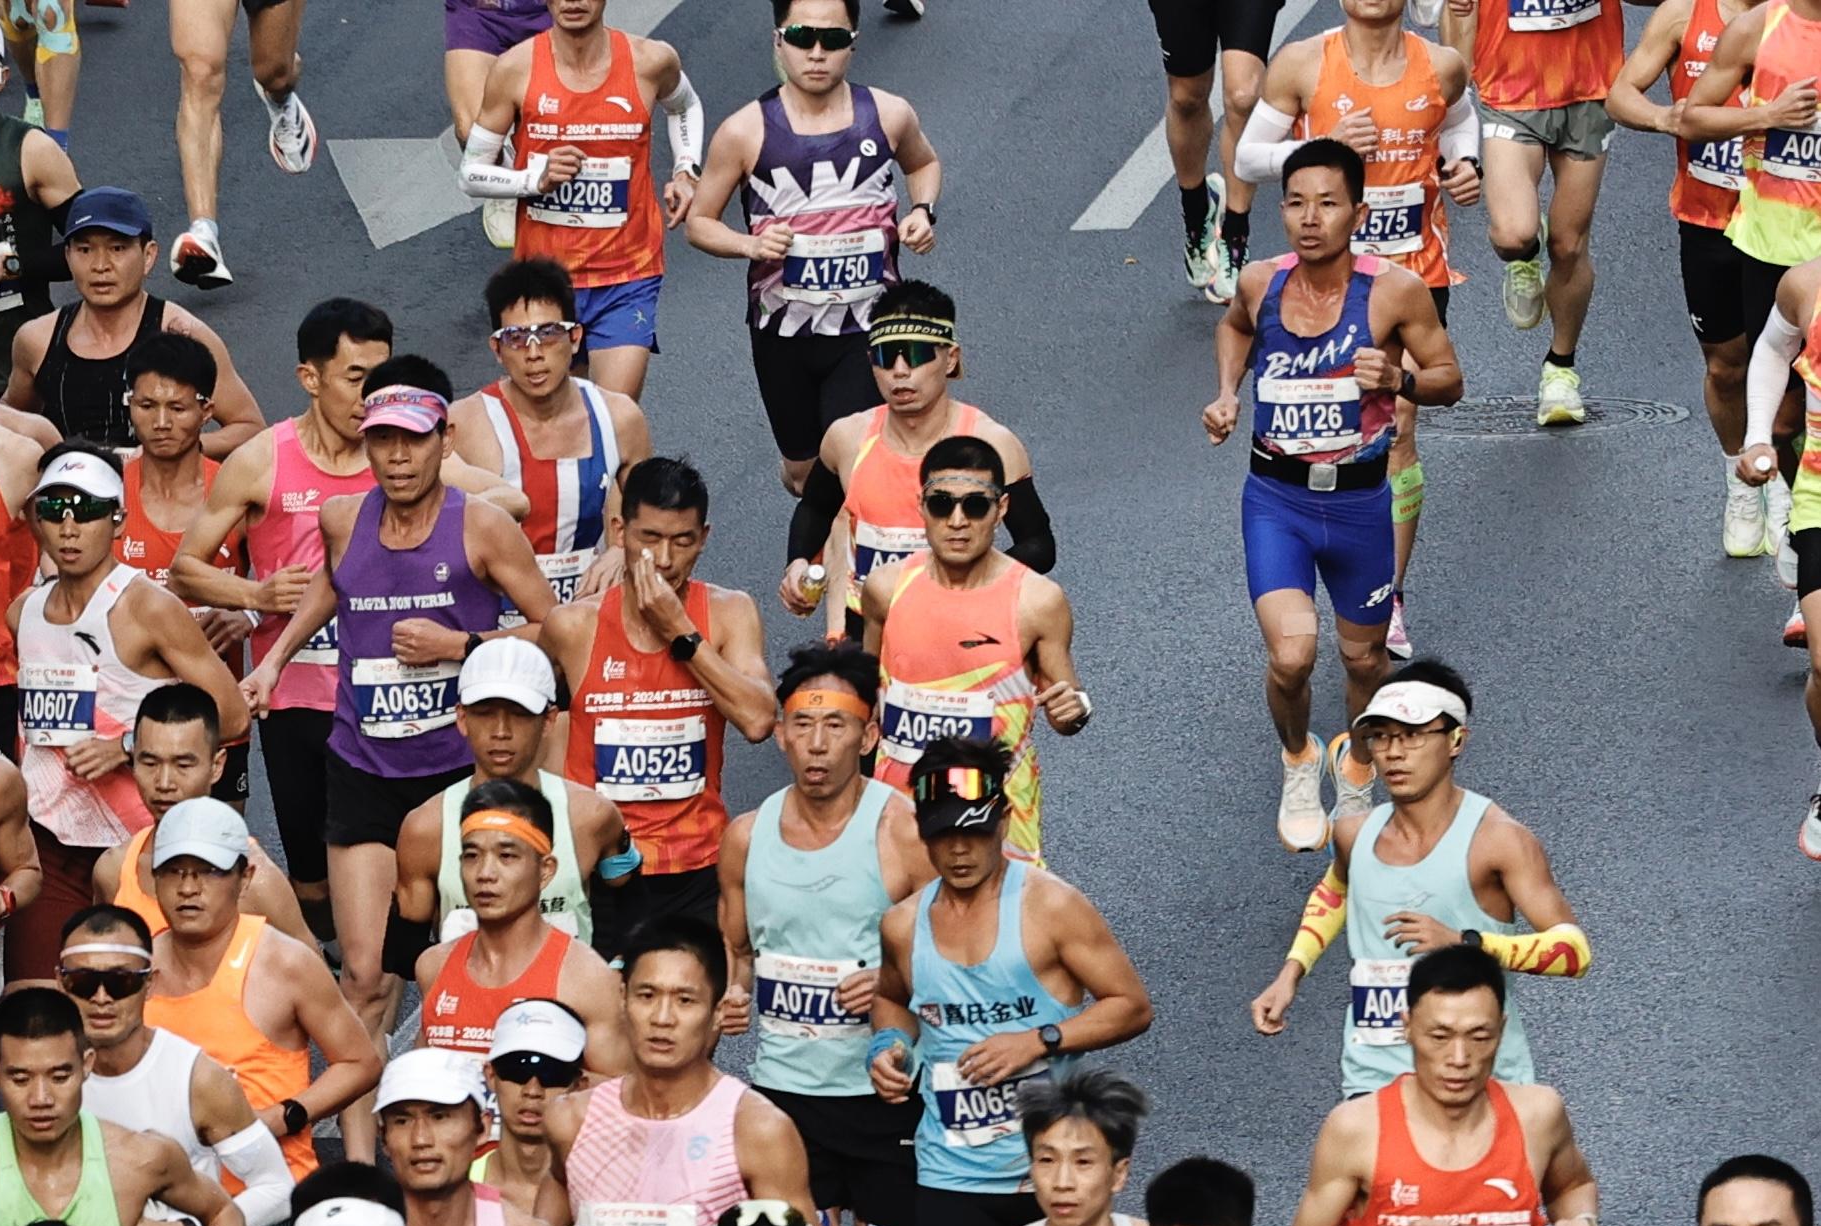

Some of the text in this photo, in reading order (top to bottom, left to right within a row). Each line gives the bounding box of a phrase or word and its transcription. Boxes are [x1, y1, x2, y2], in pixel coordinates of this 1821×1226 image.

[1381, 128, 1426, 145] 科技
[544, 182, 613, 206] A0208
[799, 255, 869, 284] A1750
[1270, 404, 1343, 431] A0126
[389, 596, 412, 610] NON
[413, 592, 455, 609] VERBA
[23, 692, 79, 722] A0607
[371, 681, 448, 715] A0637
[612, 745, 693, 777] A0525
[1363, 987, 1409, 1019] A04
[953, 1083, 1018, 1123] A065
